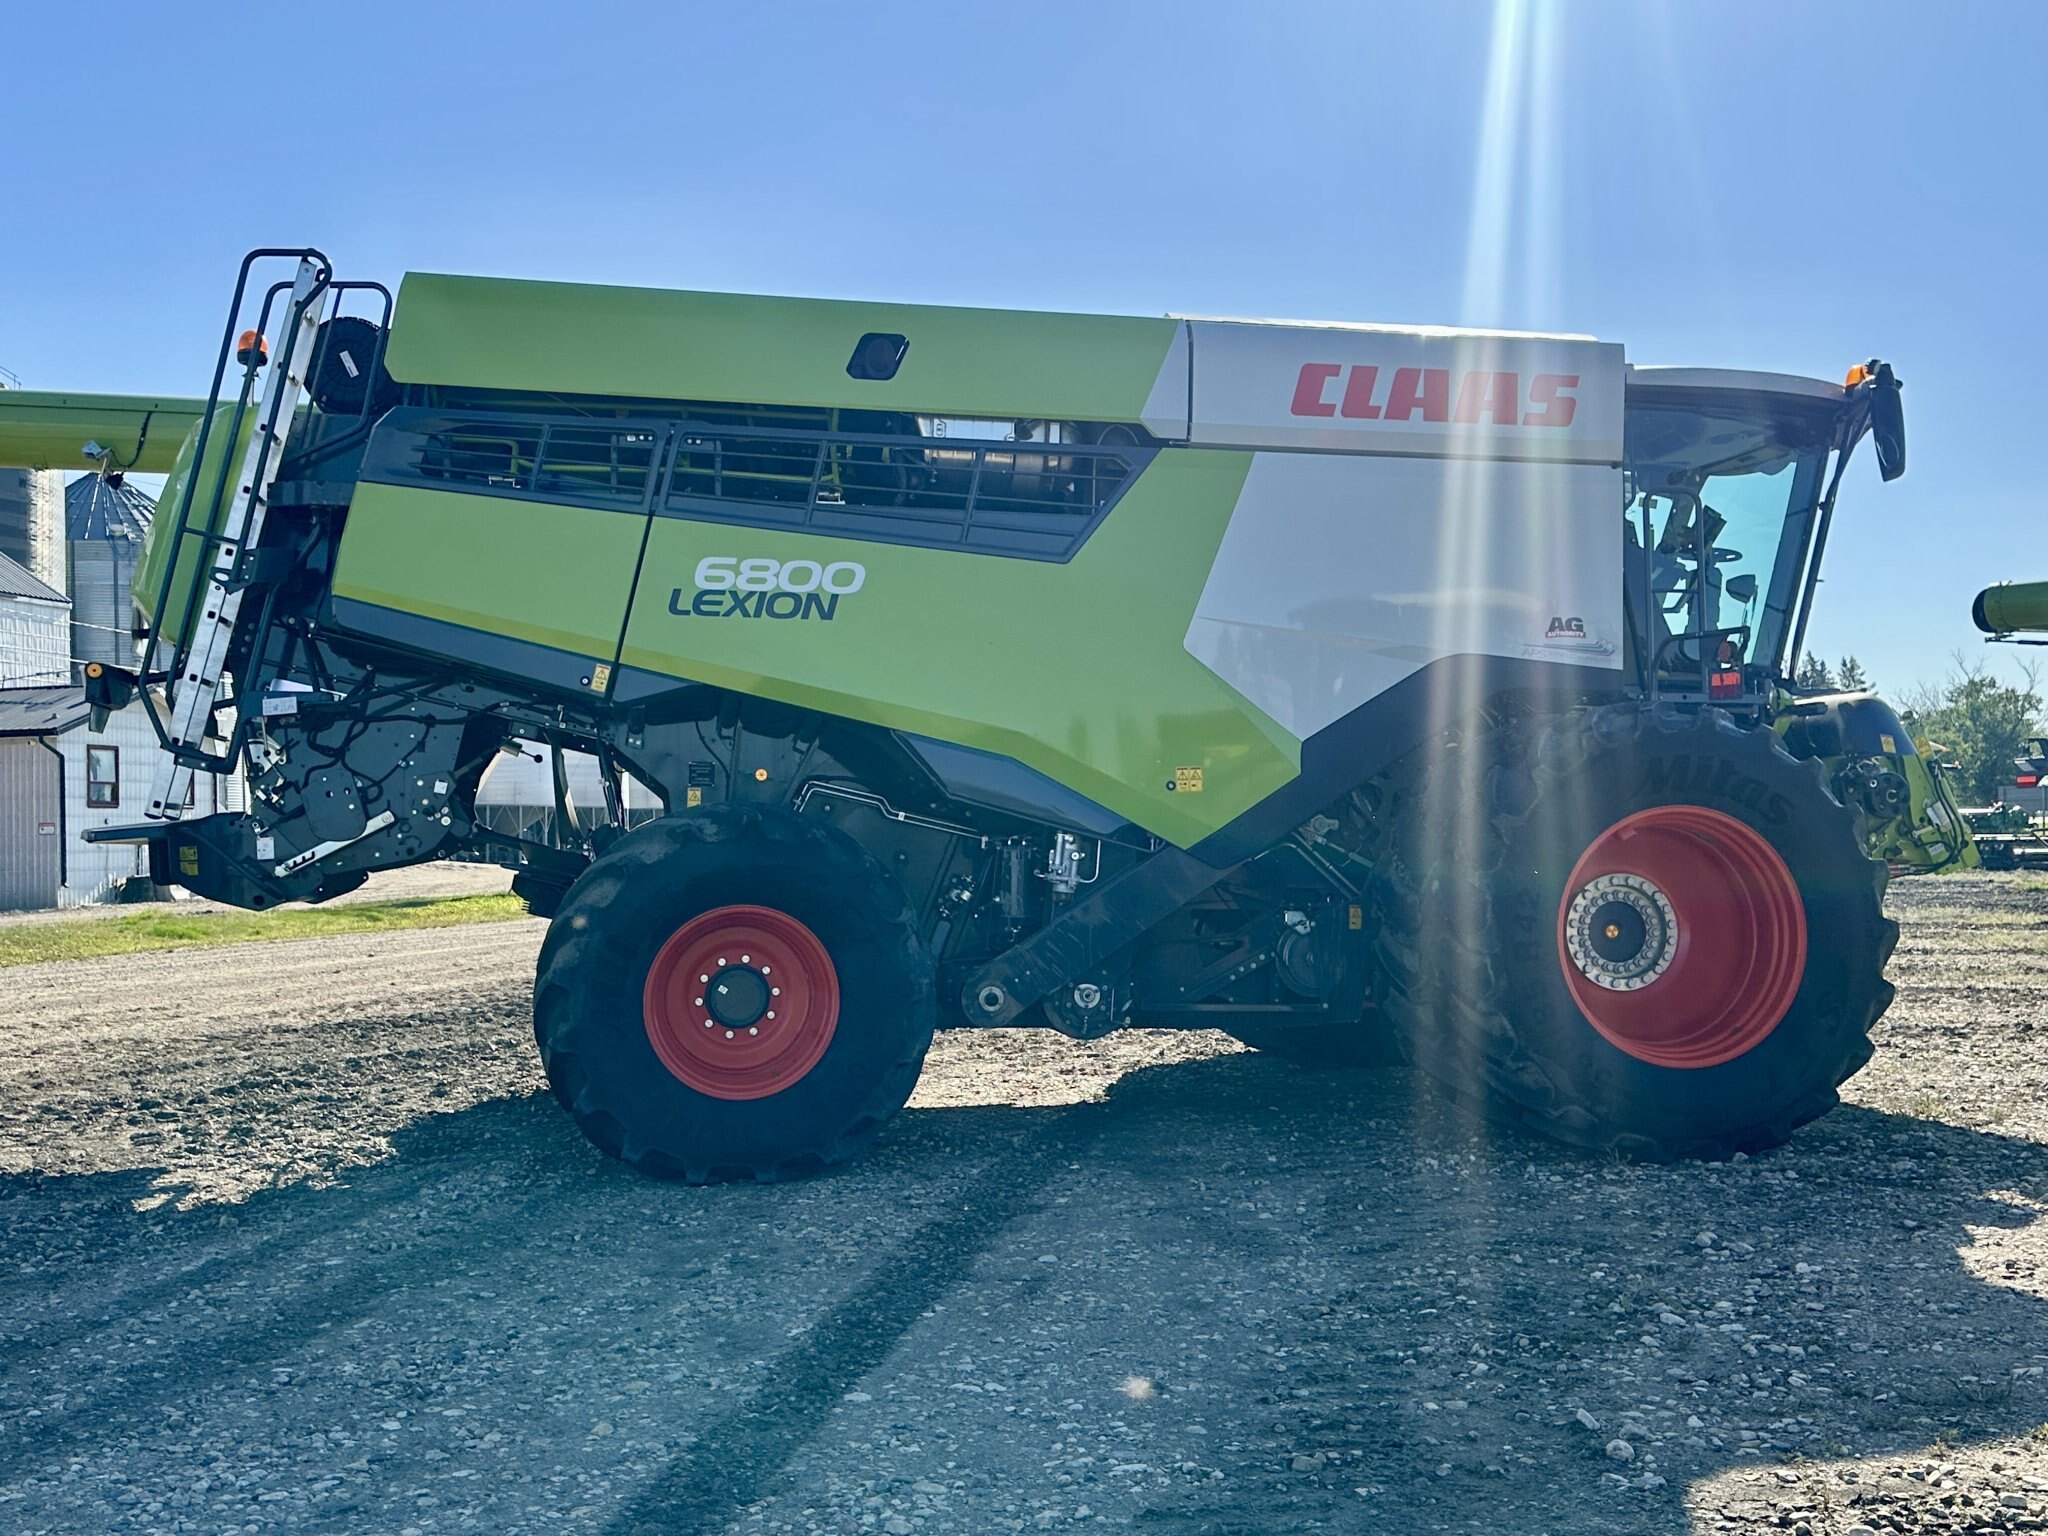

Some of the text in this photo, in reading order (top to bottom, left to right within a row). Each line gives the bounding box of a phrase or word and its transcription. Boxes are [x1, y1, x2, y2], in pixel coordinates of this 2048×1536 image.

[1290, 363, 1580, 427] CLAAS
[694, 556, 866, 594] 6800
[668, 588, 840, 621] LEXION
[1548, 617, 1584, 632] AG
[1628, 754, 1797, 826] Mitas
